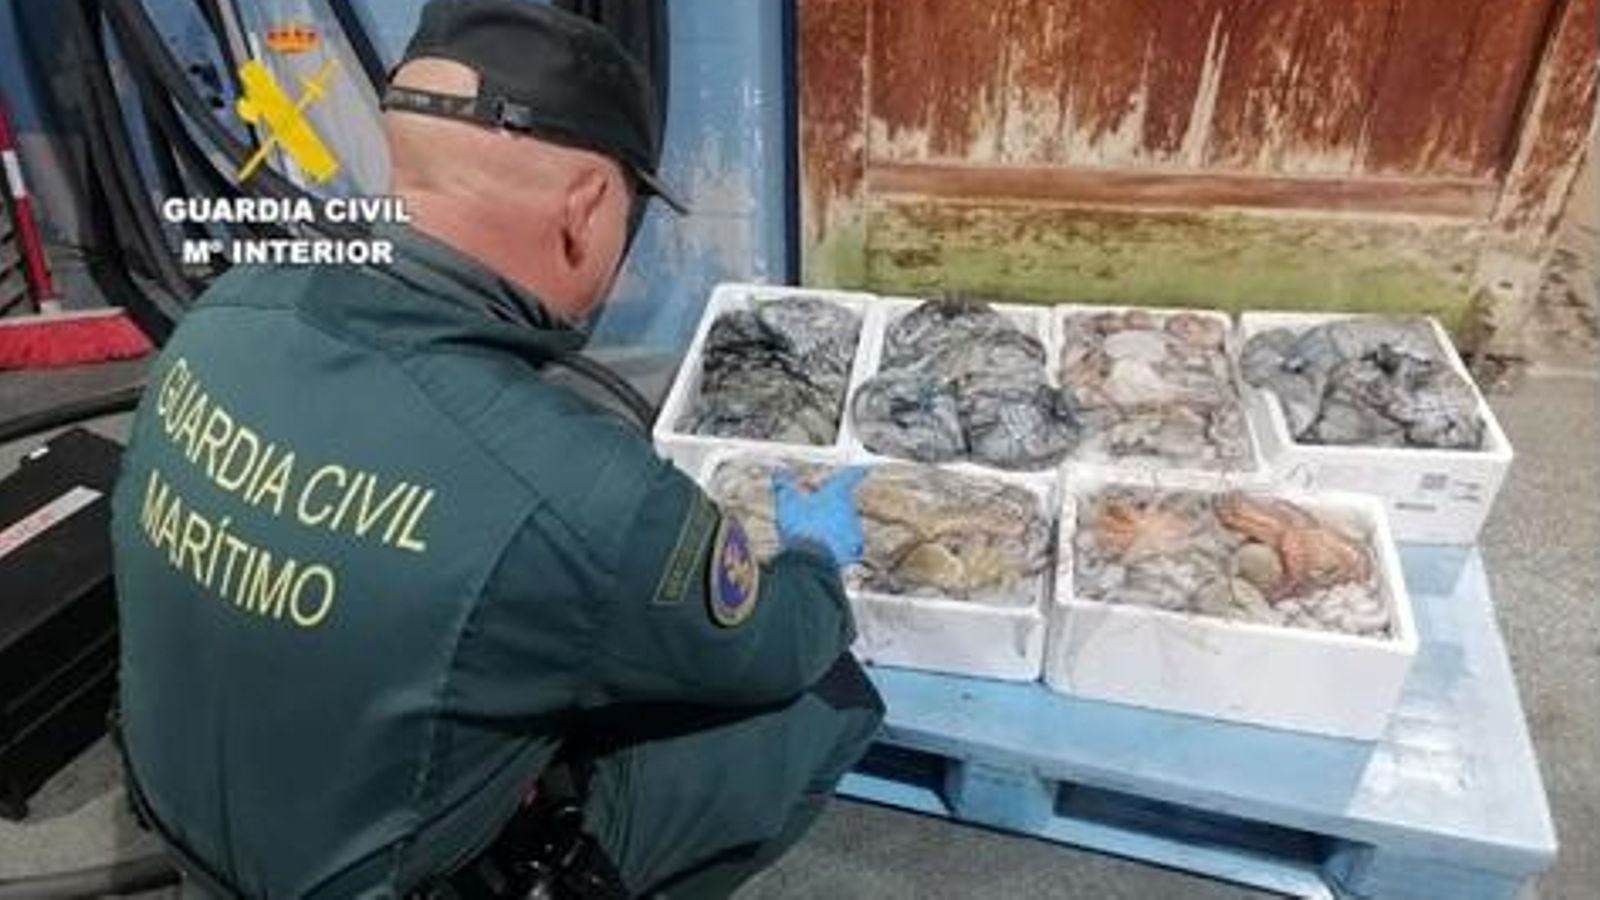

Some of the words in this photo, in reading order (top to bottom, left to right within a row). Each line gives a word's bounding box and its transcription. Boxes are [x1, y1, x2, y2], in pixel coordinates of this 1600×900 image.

[157, 357, 297, 515] GUARDIA
[297, 464, 436, 552] CIVIL
[142, 469, 336, 627] MARÍTIMO
